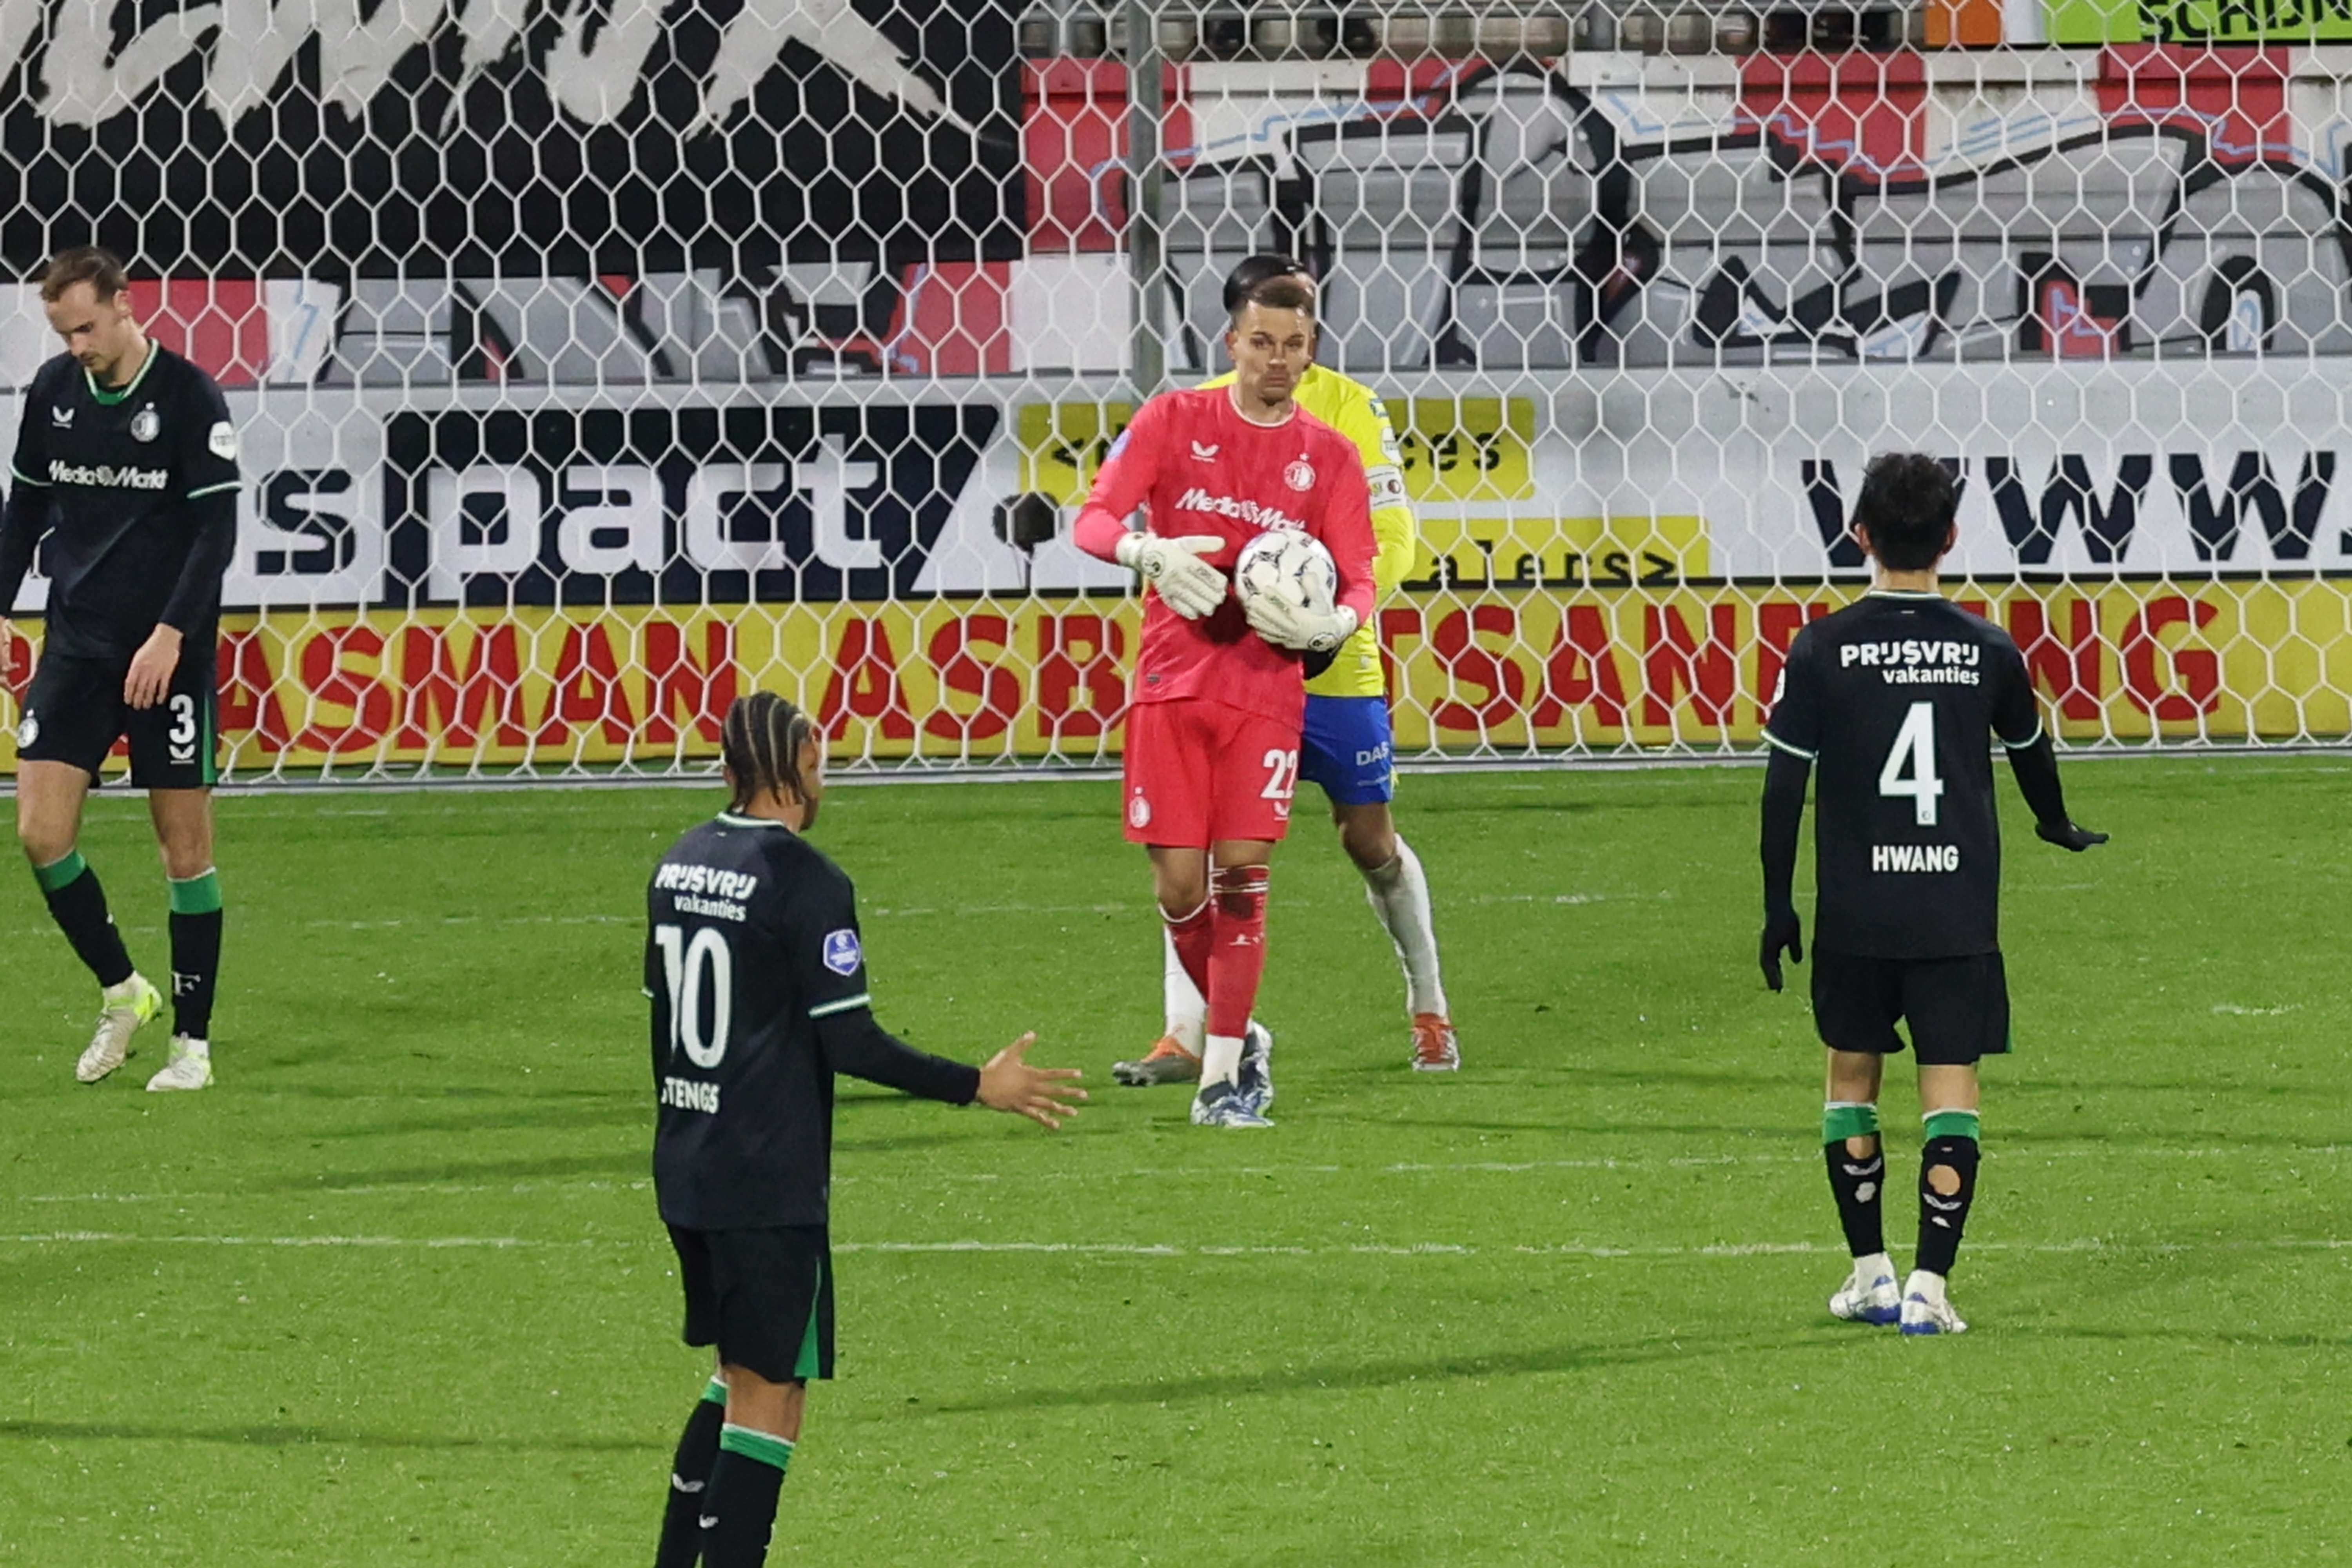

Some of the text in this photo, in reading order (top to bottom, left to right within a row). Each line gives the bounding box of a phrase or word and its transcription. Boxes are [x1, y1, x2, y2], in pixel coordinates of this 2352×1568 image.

[1882, 666, 1980, 686] vakanties
[169, 695, 195, 744] 3
[1879, 702, 1944, 826] 4
[1872, 846, 1958, 872] HWANG
[674, 893, 746, 922] vakanties
[655, 924, 731, 1068] 10
